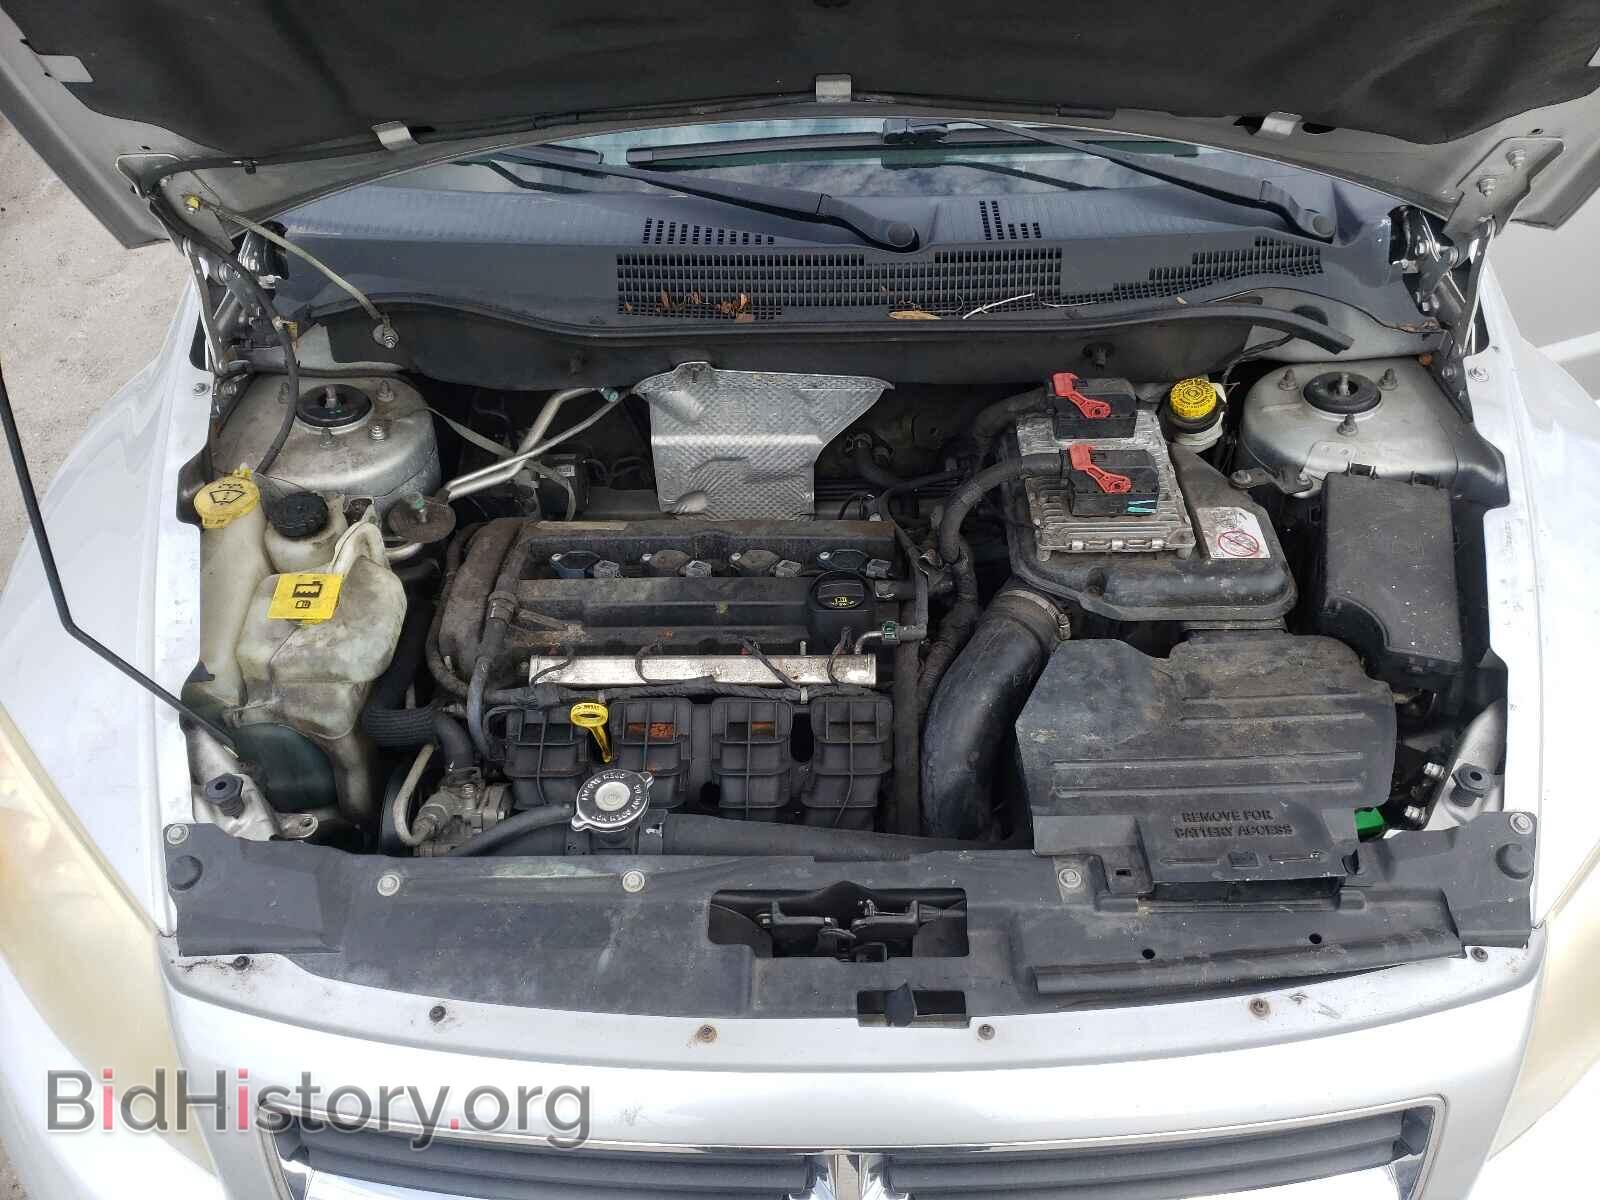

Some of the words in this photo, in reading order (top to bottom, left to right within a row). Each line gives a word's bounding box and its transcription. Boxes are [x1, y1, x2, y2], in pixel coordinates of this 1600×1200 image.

[1182, 810, 1240, 822] REMOVE
[1242, 809, 1273, 821] FOR
[1174, 825, 1233, 838] BATTERY
[1237, 823, 1294, 836] ACCESS
